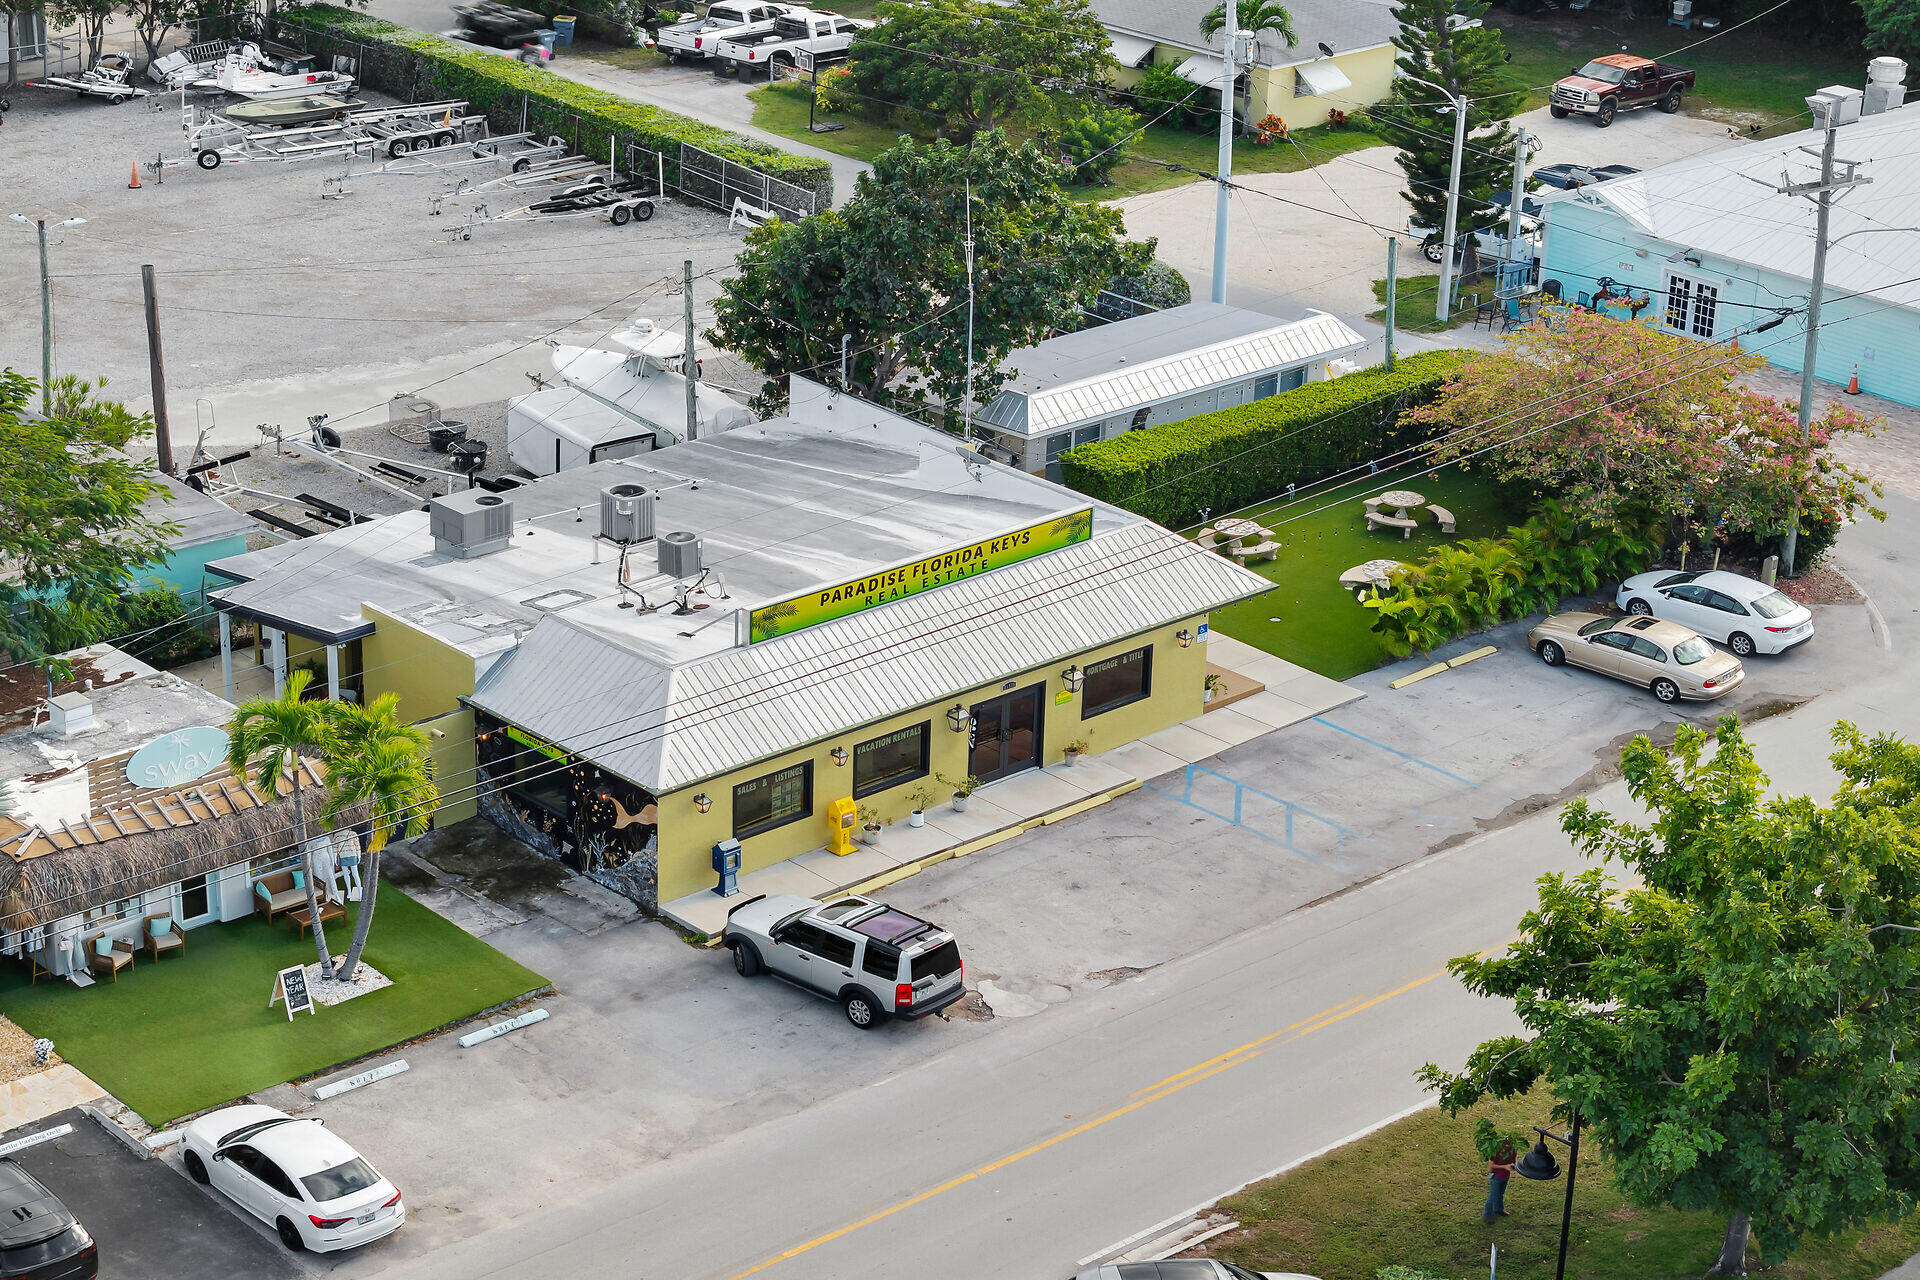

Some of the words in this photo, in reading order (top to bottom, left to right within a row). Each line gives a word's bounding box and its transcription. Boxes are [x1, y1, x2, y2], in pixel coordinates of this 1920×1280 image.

[820, 569, 906, 606] PARADISE
[912, 546, 983, 578] FLORIDA
[990, 531, 1030, 555] KEYS
[865, 584, 909, 606] REAL
[922, 558, 988, 588] ESTATE
[1122, 656, 1128, 664] &
[520, 732, 541, 746] FLORIDA
[856, 736, 892, 755] VACATION
[892, 725, 922, 743] RENTALS
[144, 746, 214, 782] sway
[737, 782, 757, 796] SALES
[762, 778, 768, 788] &
[774, 766, 803, 783] LISTINGS
[285, 974, 303, 986] NEW
[286, 982, 305, 994] YEAR
[19, 1134, 46, 1145] Parking
[46, 1127, 62, 1137] Only
